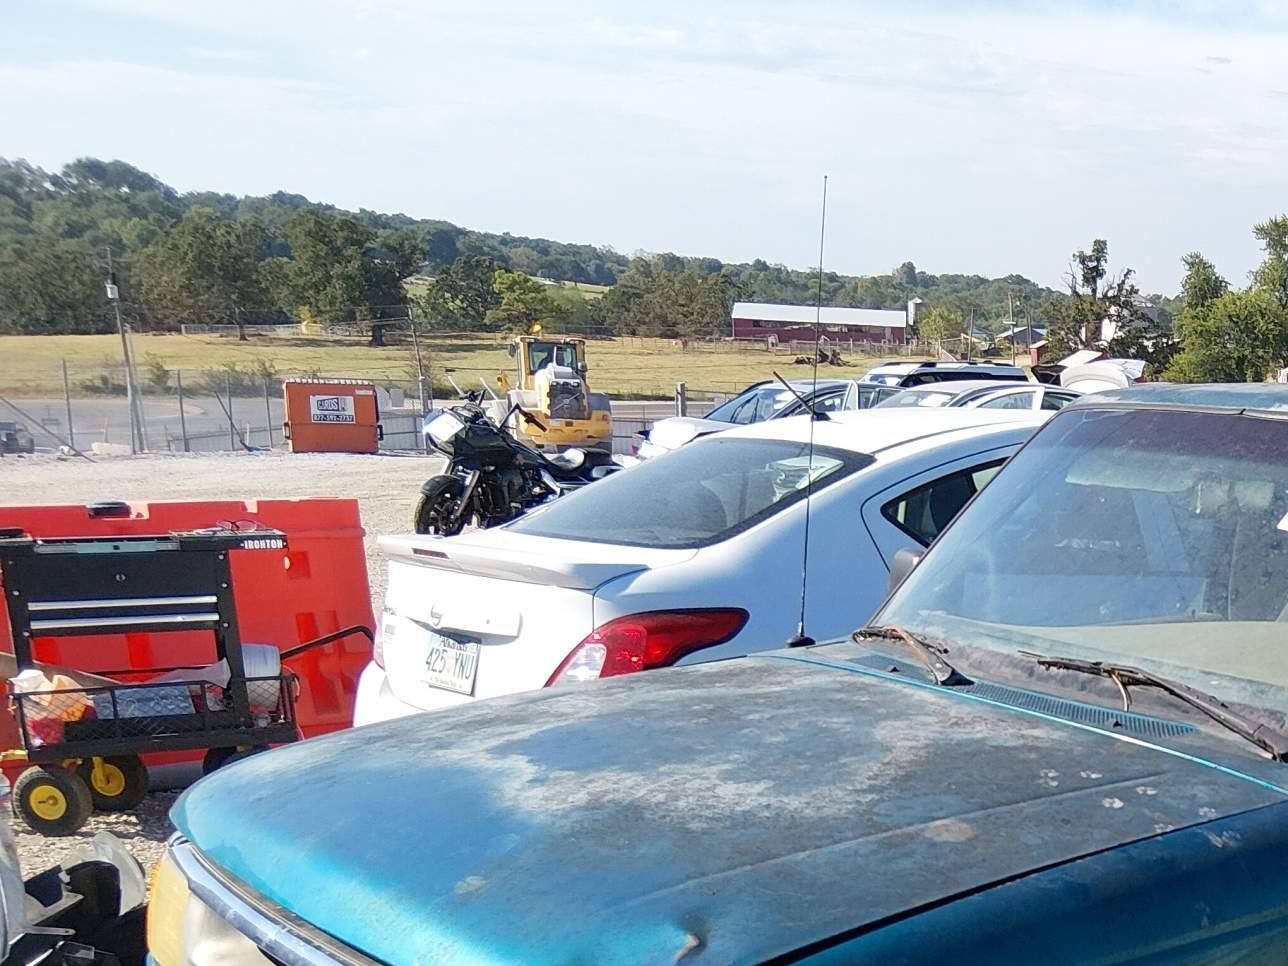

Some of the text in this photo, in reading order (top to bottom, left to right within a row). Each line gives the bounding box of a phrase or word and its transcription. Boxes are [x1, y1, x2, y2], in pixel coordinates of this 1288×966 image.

[243, 539, 283, 549] IRONTON
[425, 647, 475, 681] 425 YNU
